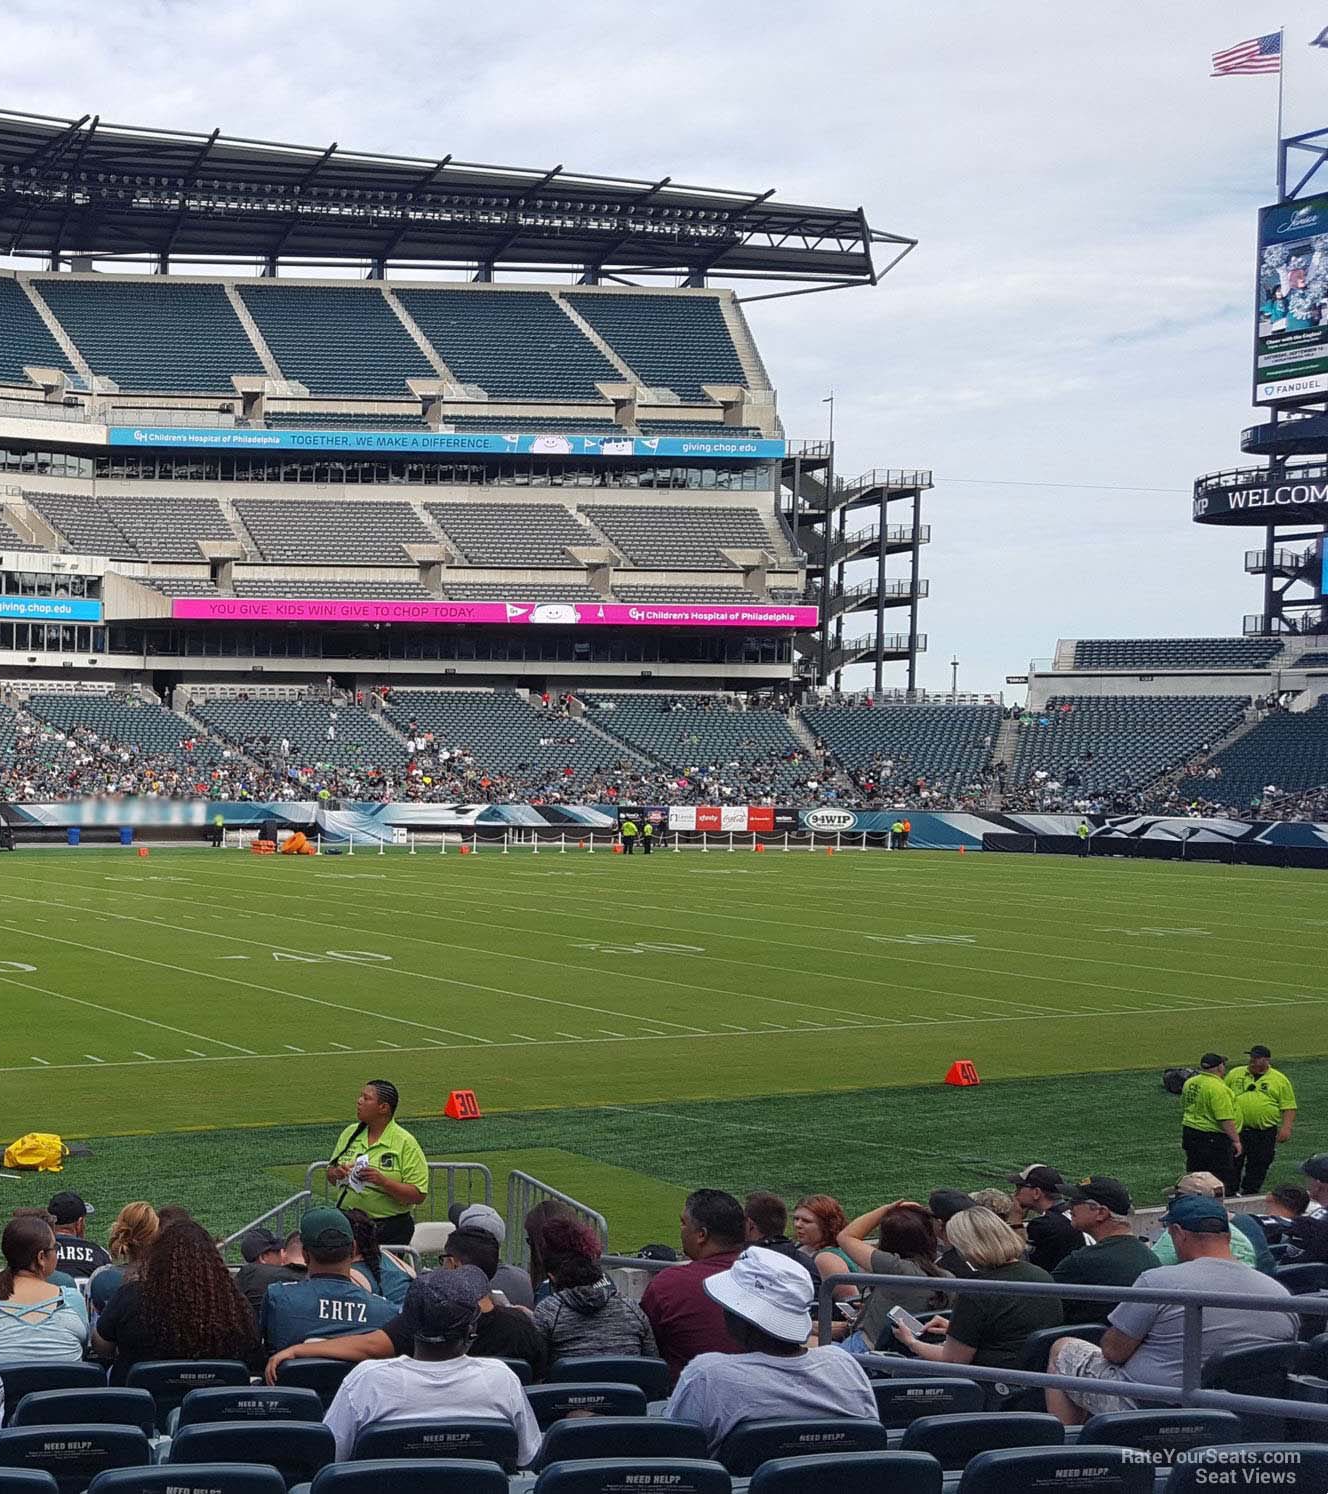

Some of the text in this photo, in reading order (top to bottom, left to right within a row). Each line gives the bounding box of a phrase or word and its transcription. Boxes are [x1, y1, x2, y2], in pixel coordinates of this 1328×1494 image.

[1277, 381, 1321, 394] FANDUEL
[148, 433, 187, 442] Children's
[188, 434, 221, 443] Hospital
[222, 435, 231, 443] of
[232, 435, 280, 445] Philadelphia
[290, 435, 492, 449] TOGETHER, WE MAKE A DIFFERENCE.
[682, 443, 757, 453] giving.chop.edu
[210, 604, 235, 615] YOU
[276, 605, 304, 616] KIDS
[309, 605, 337, 616] WIN!
[340, 607, 369, 616] GIVE
[374, 607, 390, 617] TO
[393, 607, 429, 617] CHOP
[432, 607, 476, 618] TODAY.
[645, 611, 690, 620] Children's
[691, 612, 728, 622] Hospital
[741, 612, 795, 622] Philadelphia
[455, 1093, 480, 1115] 30
[319, 1298, 367, 1323] ERTZ
[1056, 1468, 1109, 1478] NEED HELP?
[627, 1475, 681, 1484] NEED HELP?
